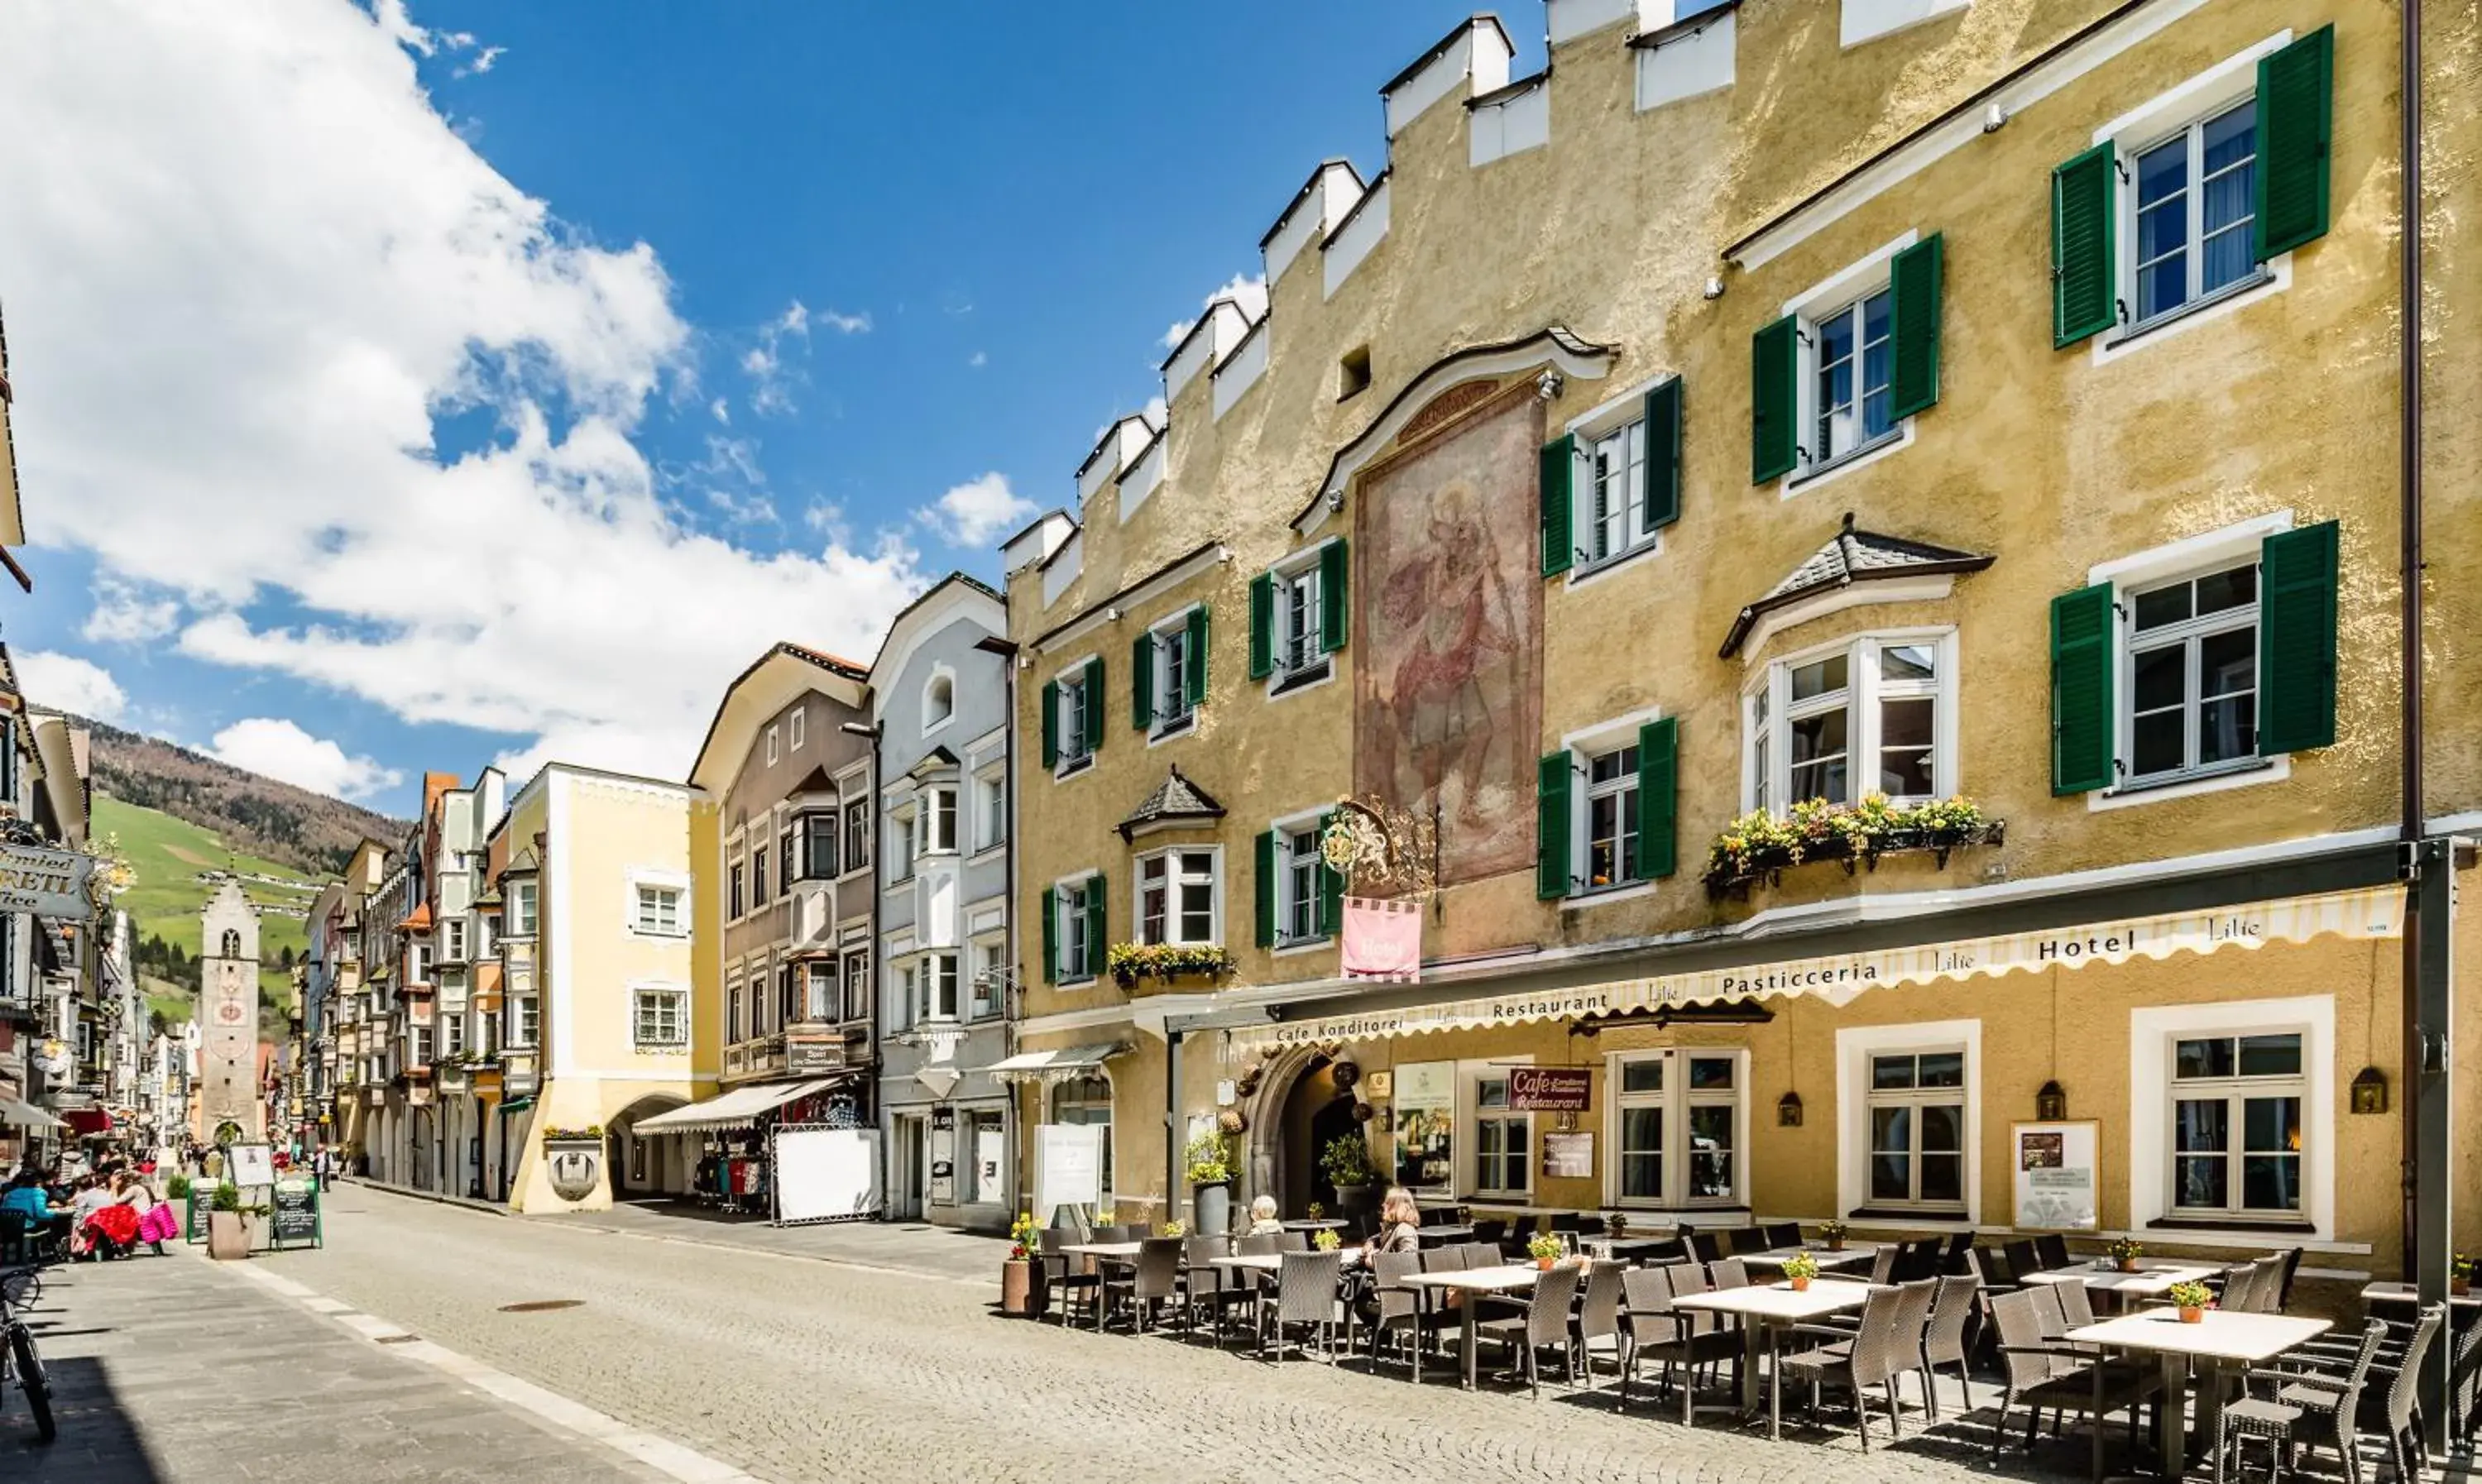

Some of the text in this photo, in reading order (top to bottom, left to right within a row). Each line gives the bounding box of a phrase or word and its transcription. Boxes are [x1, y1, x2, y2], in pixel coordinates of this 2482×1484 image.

[2209, 917, 2260, 941] Lilie
[2039, 930, 2135, 960] Hotel
[1934, 951, 1975, 972] Lilie
[1723, 963, 1876, 993] Pasticceria
[1648, 983, 1678, 1002] Lilie
[1493, 994, 1607, 1018] Restaurant
[1277, 1017, 1404, 1041] Cafe Konditorei
[1513, 1071, 1550, 1099] Cafe
[1517, 1094, 1584, 1111] Restaurant
